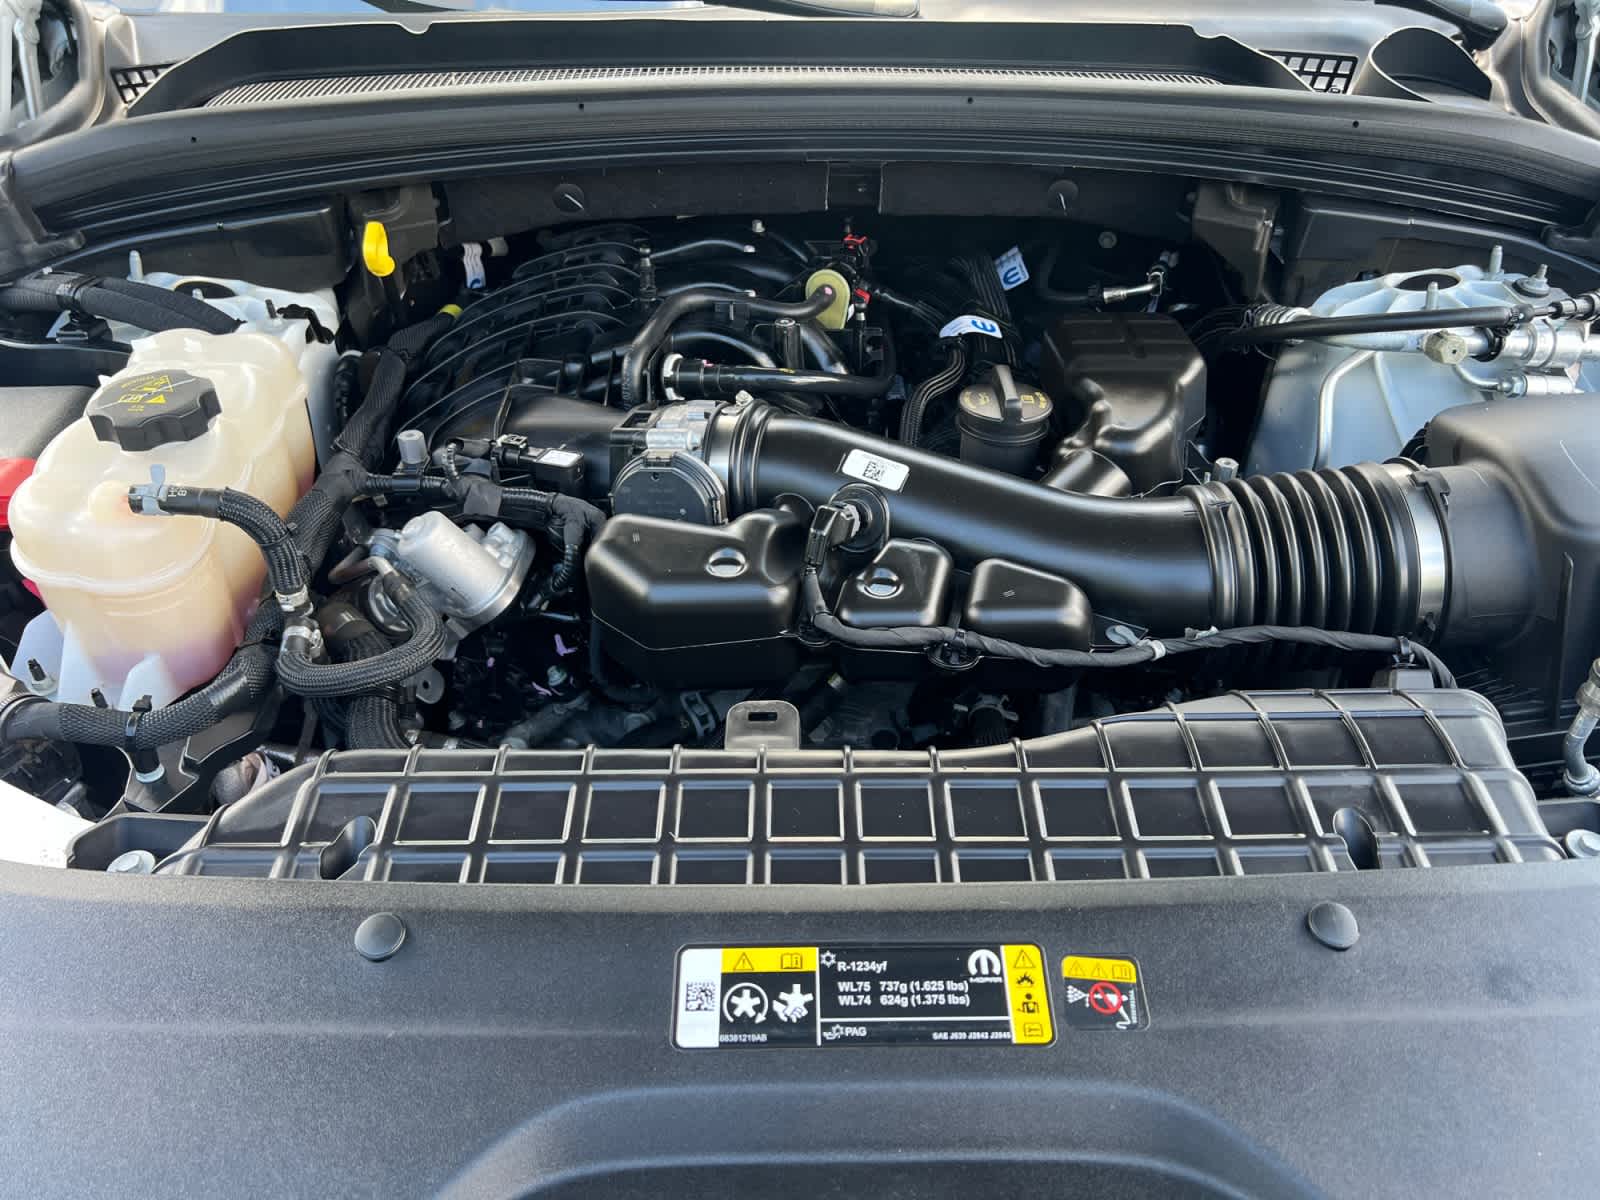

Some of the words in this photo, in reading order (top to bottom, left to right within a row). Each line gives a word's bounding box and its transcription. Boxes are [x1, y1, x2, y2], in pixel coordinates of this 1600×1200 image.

[837, 961, 888, 974] R-1234yf
[838, 981, 871, 992] WL75
[879, 981, 908, 993] 737g
[909, 980, 945, 993] (1.625
[946, 980, 969, 993] lbs)
[838, 995, 872, 1006] WL74
[880, 995, 909, 1007] 624g
[910, 993, 946, 1007] (1.375
[947, 993, 970, 1007] lbs)
[845, 1026, 867, 1037] PAG
